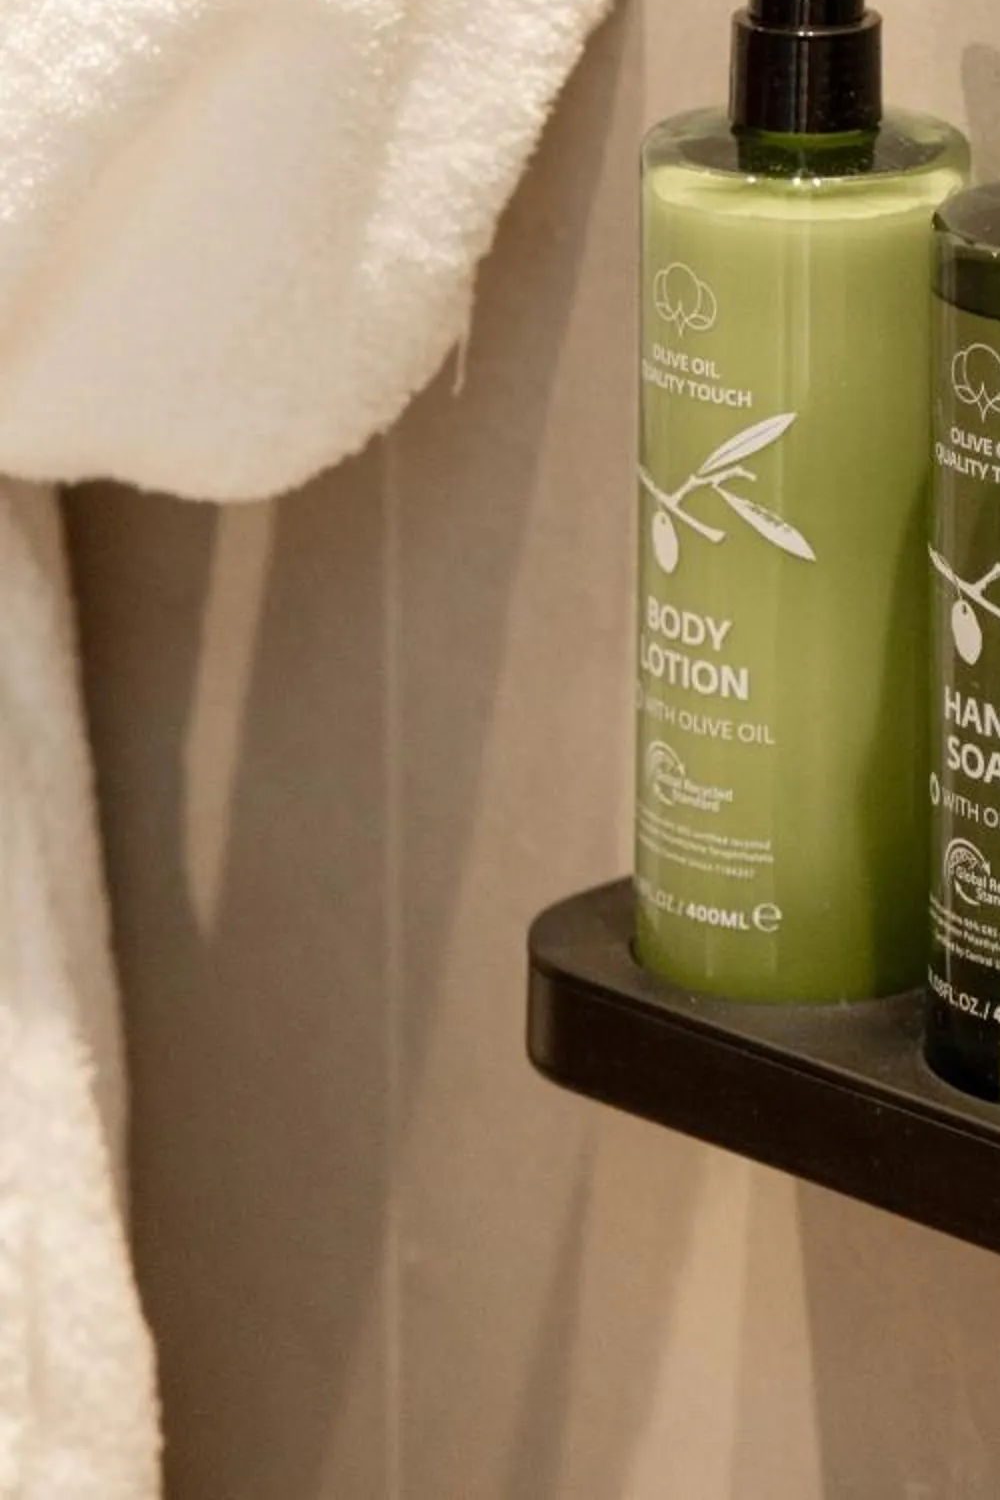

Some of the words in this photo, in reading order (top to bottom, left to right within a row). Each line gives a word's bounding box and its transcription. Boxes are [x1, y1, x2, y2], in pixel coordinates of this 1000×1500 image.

[653, 343, 689, 372] OLIVE
[691, 357, 720, 379] OIL
[687, 379, 752, 408] TOUCH
[951, 427, 992, 455] OLIVE
[935, 442, 989, 481] QUALITY
[647, 595, 732, 651] BODY
[640, 634, 750, 700] LOTION
[679, 709, 733, 740] OLIVE
[737, 722, 775, 744] OIL
[942, 786, 979, 823] WITH
[686, 902, 750, 930] 400ML
